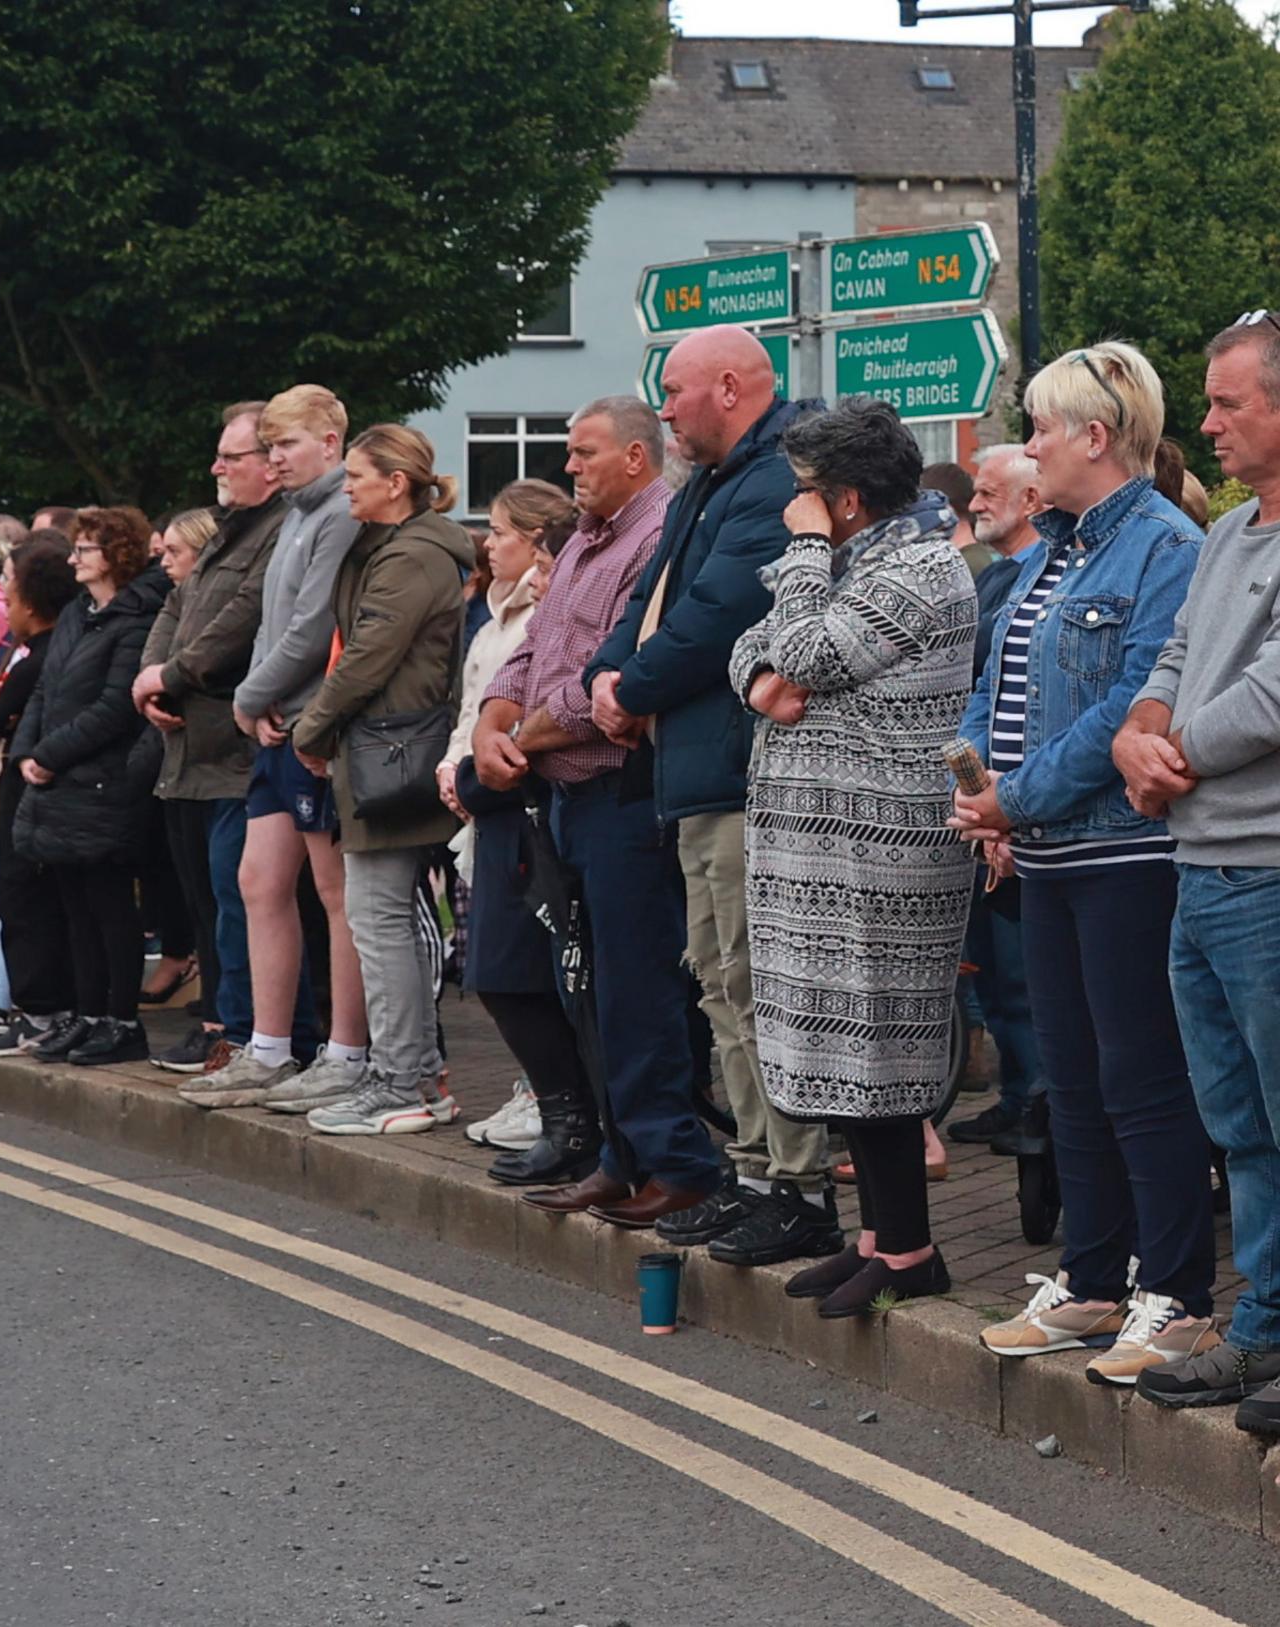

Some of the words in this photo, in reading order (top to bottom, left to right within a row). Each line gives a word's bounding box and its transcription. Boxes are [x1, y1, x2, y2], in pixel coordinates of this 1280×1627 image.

[708, 289, 785, 316] MONAGHAN
[834, 277, 886, 301] CAVAN
[838, 331, 909, 359] Droichead
[863, 353, 958, 382] Bhuitlearaigh
[905, 383, 960, 408] BRIDGE
